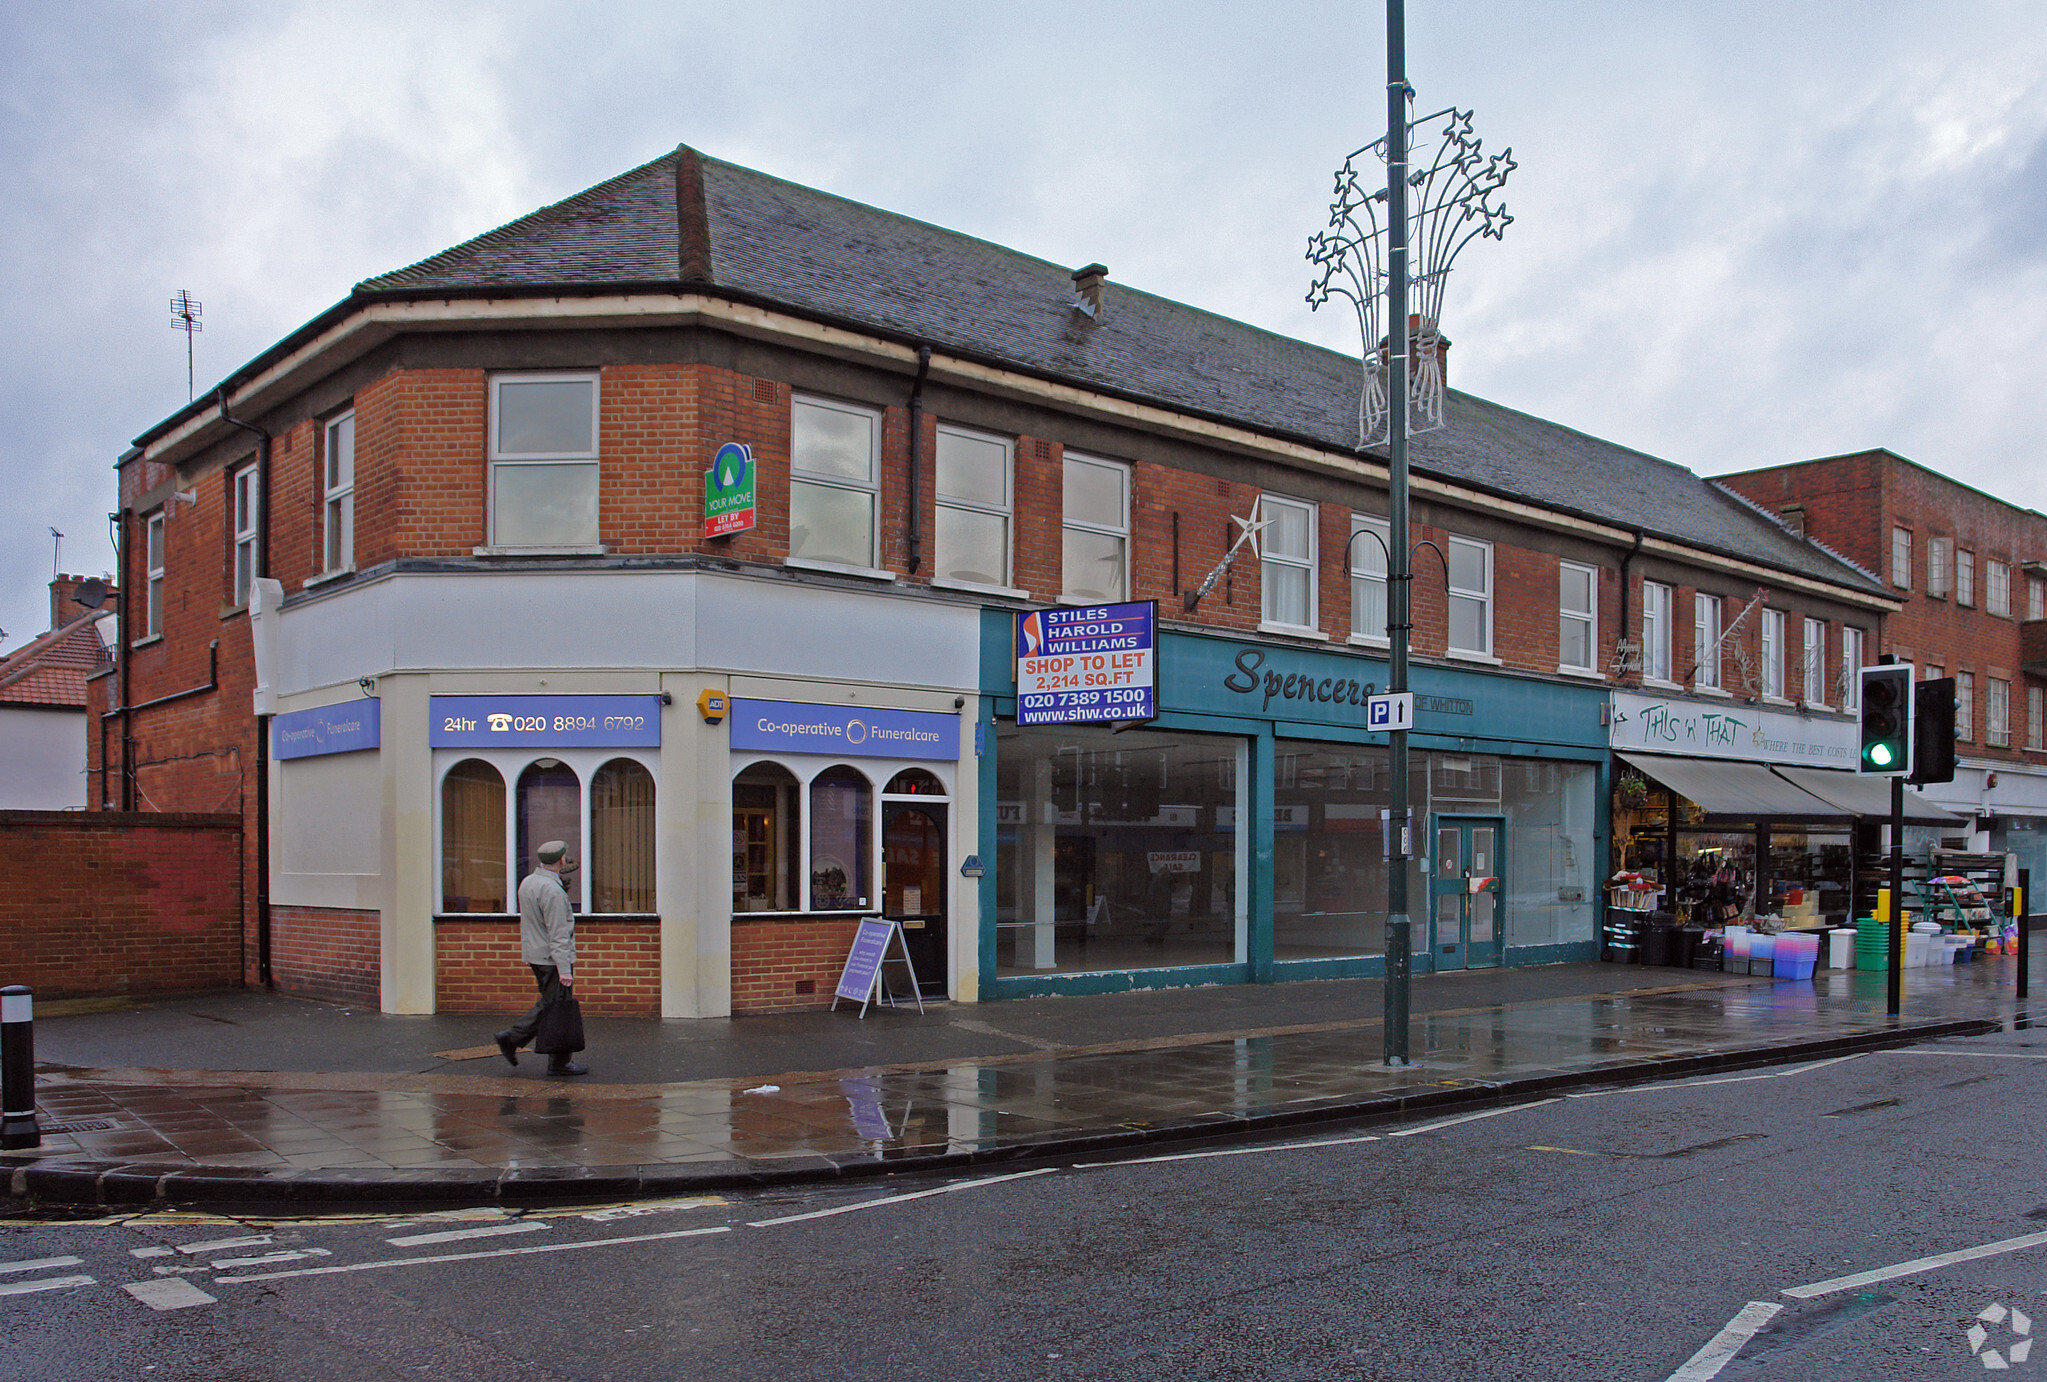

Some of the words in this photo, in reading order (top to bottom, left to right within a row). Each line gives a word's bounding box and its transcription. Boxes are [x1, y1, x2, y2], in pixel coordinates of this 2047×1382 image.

[709, 498, 727, 510] YOUR
[728, 492, 751, 506] MOVE
[718, 514, 729, 525] LET
[730, 512, 739, 522] BY
[1048, 608, 1108, 623] STILES
[1048, 623, 1123, 638] HAROLD
[1048, 637, 1138, 653] WILLIAMS
[1025, 657, 1074, 675] SHOP
[1080, 655, 1105, 671] TO
[1111, 652, 1145, 669] LET
[1036, 674, 1079, 692] 2,214
[1084, 671, 1134, 686] SQ.FT
[1224, 649, 1375, 712] Spencers
[1430, 698, 1473, 715] WHITTON
[709, 699, 724, 709] ADT
[1024, 694, 1054, 709] 020
[1058, 691, 1100, 706] 7389
[1104, 689, 1145, 704] 1500
[1024, 703, 1146, 722] www.shw.co.uk
[1374, 703, 1387, 723] P
[281, 727, 315, 743] Co-operative
[326, 718, 360, 735] Funeralcare
[444, 717, 477, 731] 24hr
[514, 716, 546, 731] 020
[553, 716, 596, 731] 8894
[604, 716, 644, 731] 6792
[757, 718, 842, 737] Co-operative
[871, 726, 940, 742] Funeralcare
[1702, 713, 1748, 747] THAT
[1763, 740, 1788, 752] WHERE
[1792, 742, 1806, 754] THE
[1808, 745, 1825, 756] BEST
[1828, 746, 1847, 758] COSTS
